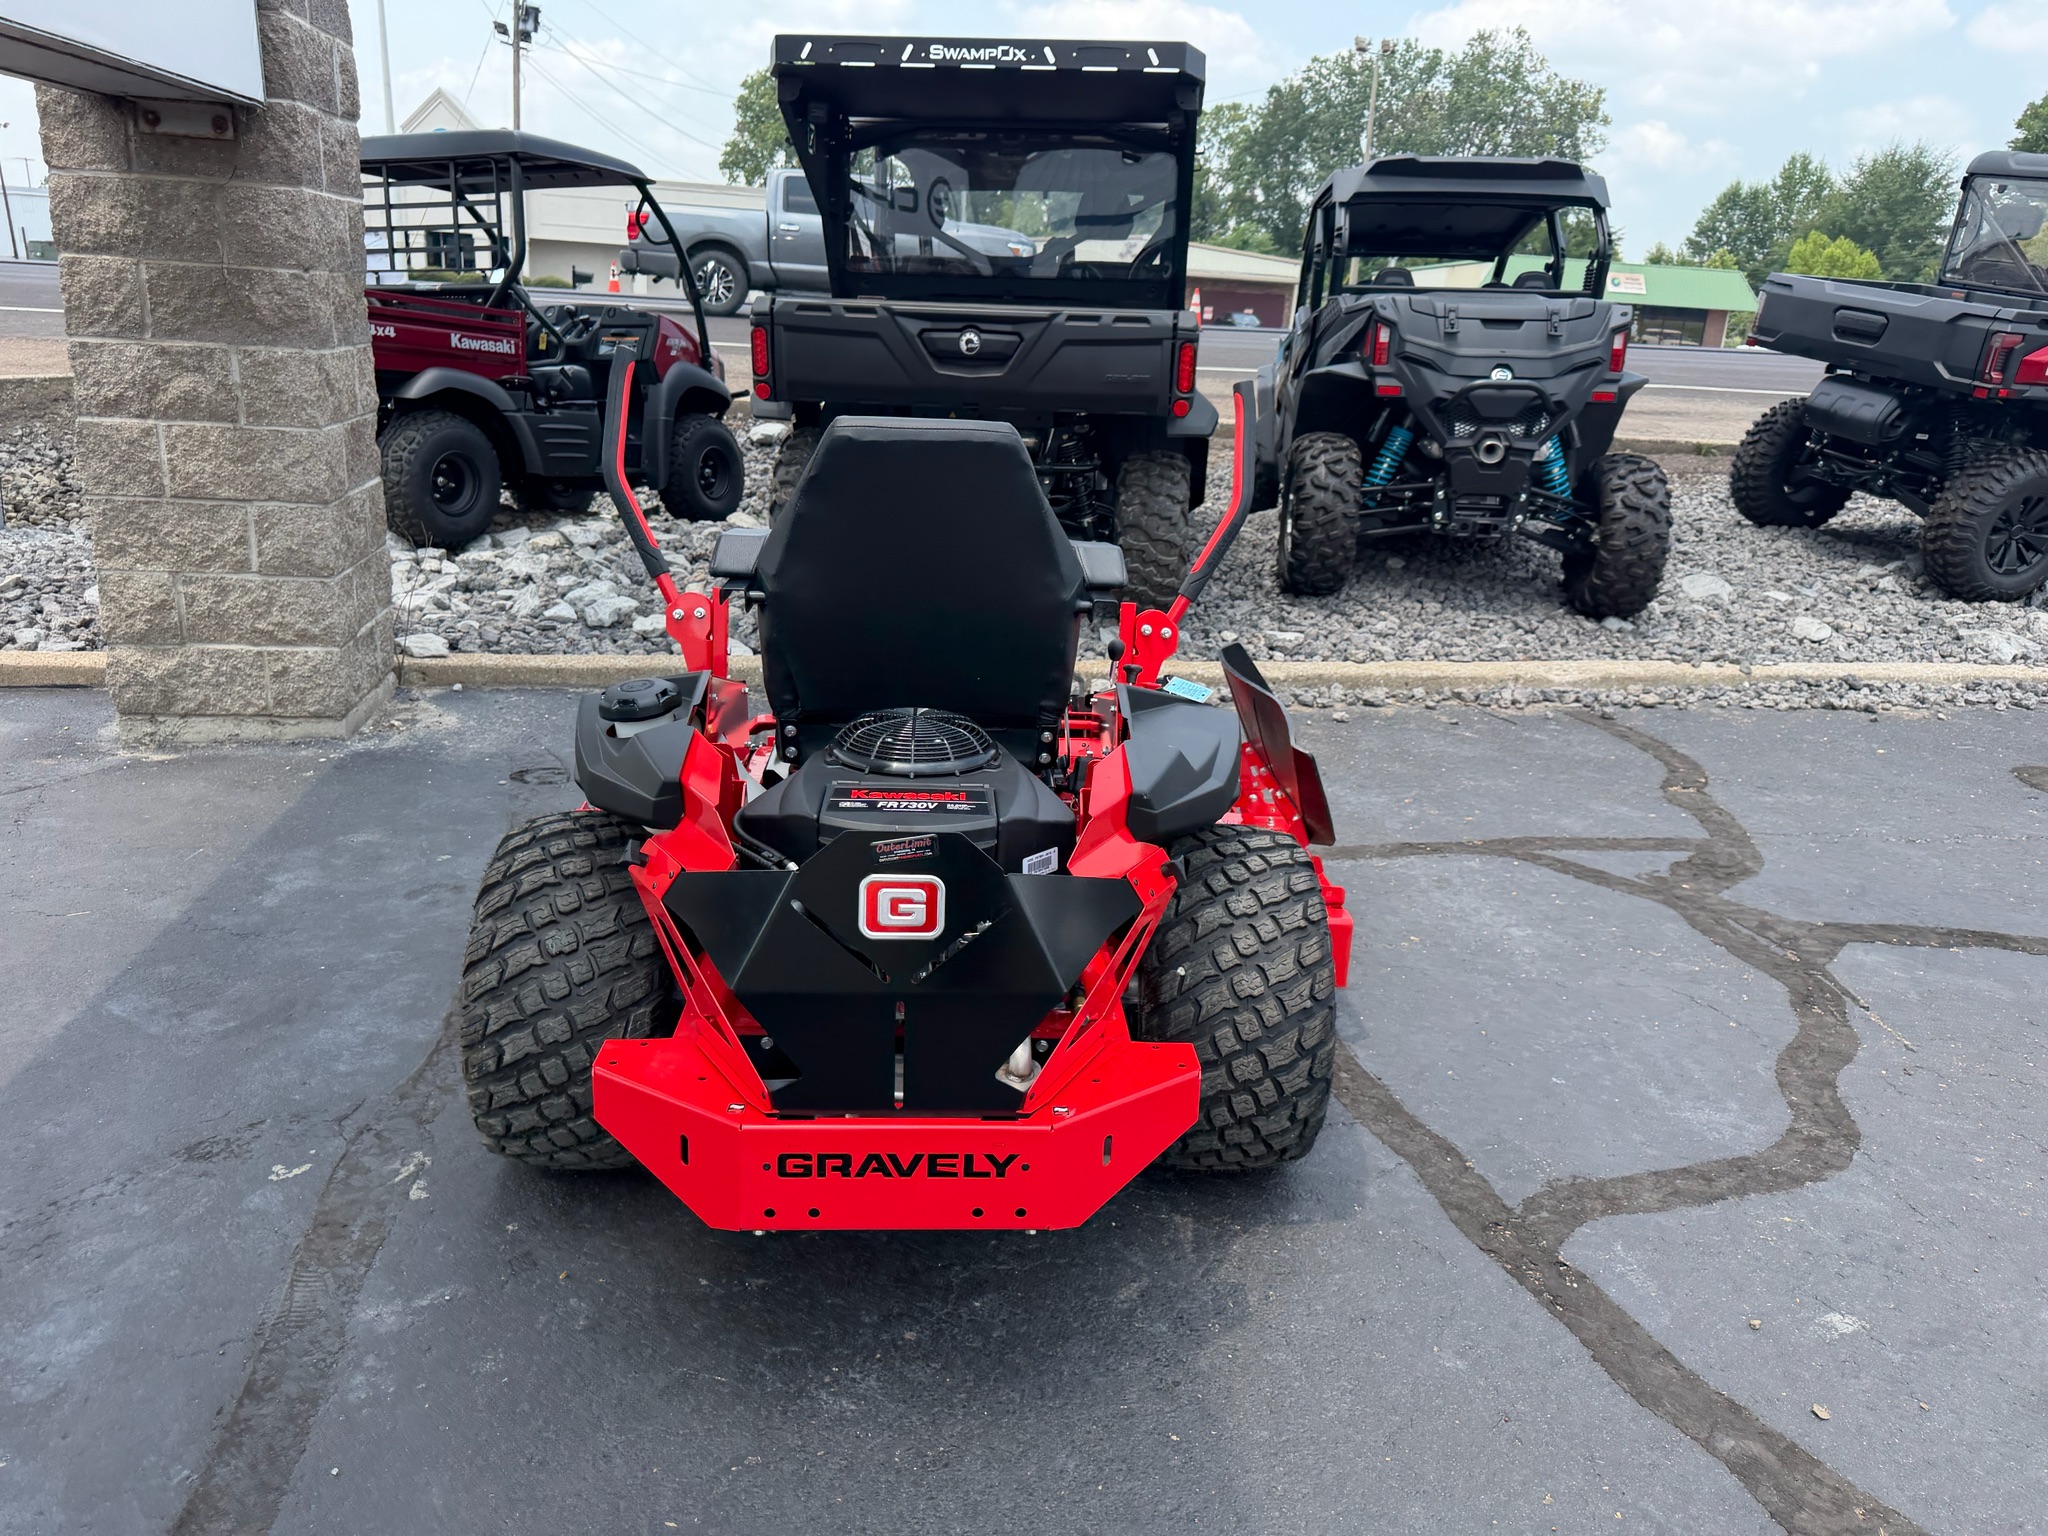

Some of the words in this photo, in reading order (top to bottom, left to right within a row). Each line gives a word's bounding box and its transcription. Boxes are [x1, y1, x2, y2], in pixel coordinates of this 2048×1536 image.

[450, 333, 516, 355] Kawasaki
[850, 789, 966, 801] Kawasaki
[877, 801, 938, 809] FR730V
[876, 838, 932, 853] OuterLimit
[877, 888, 927, 927] G
[777, 1153, 1020, 1178] GRAVELY
